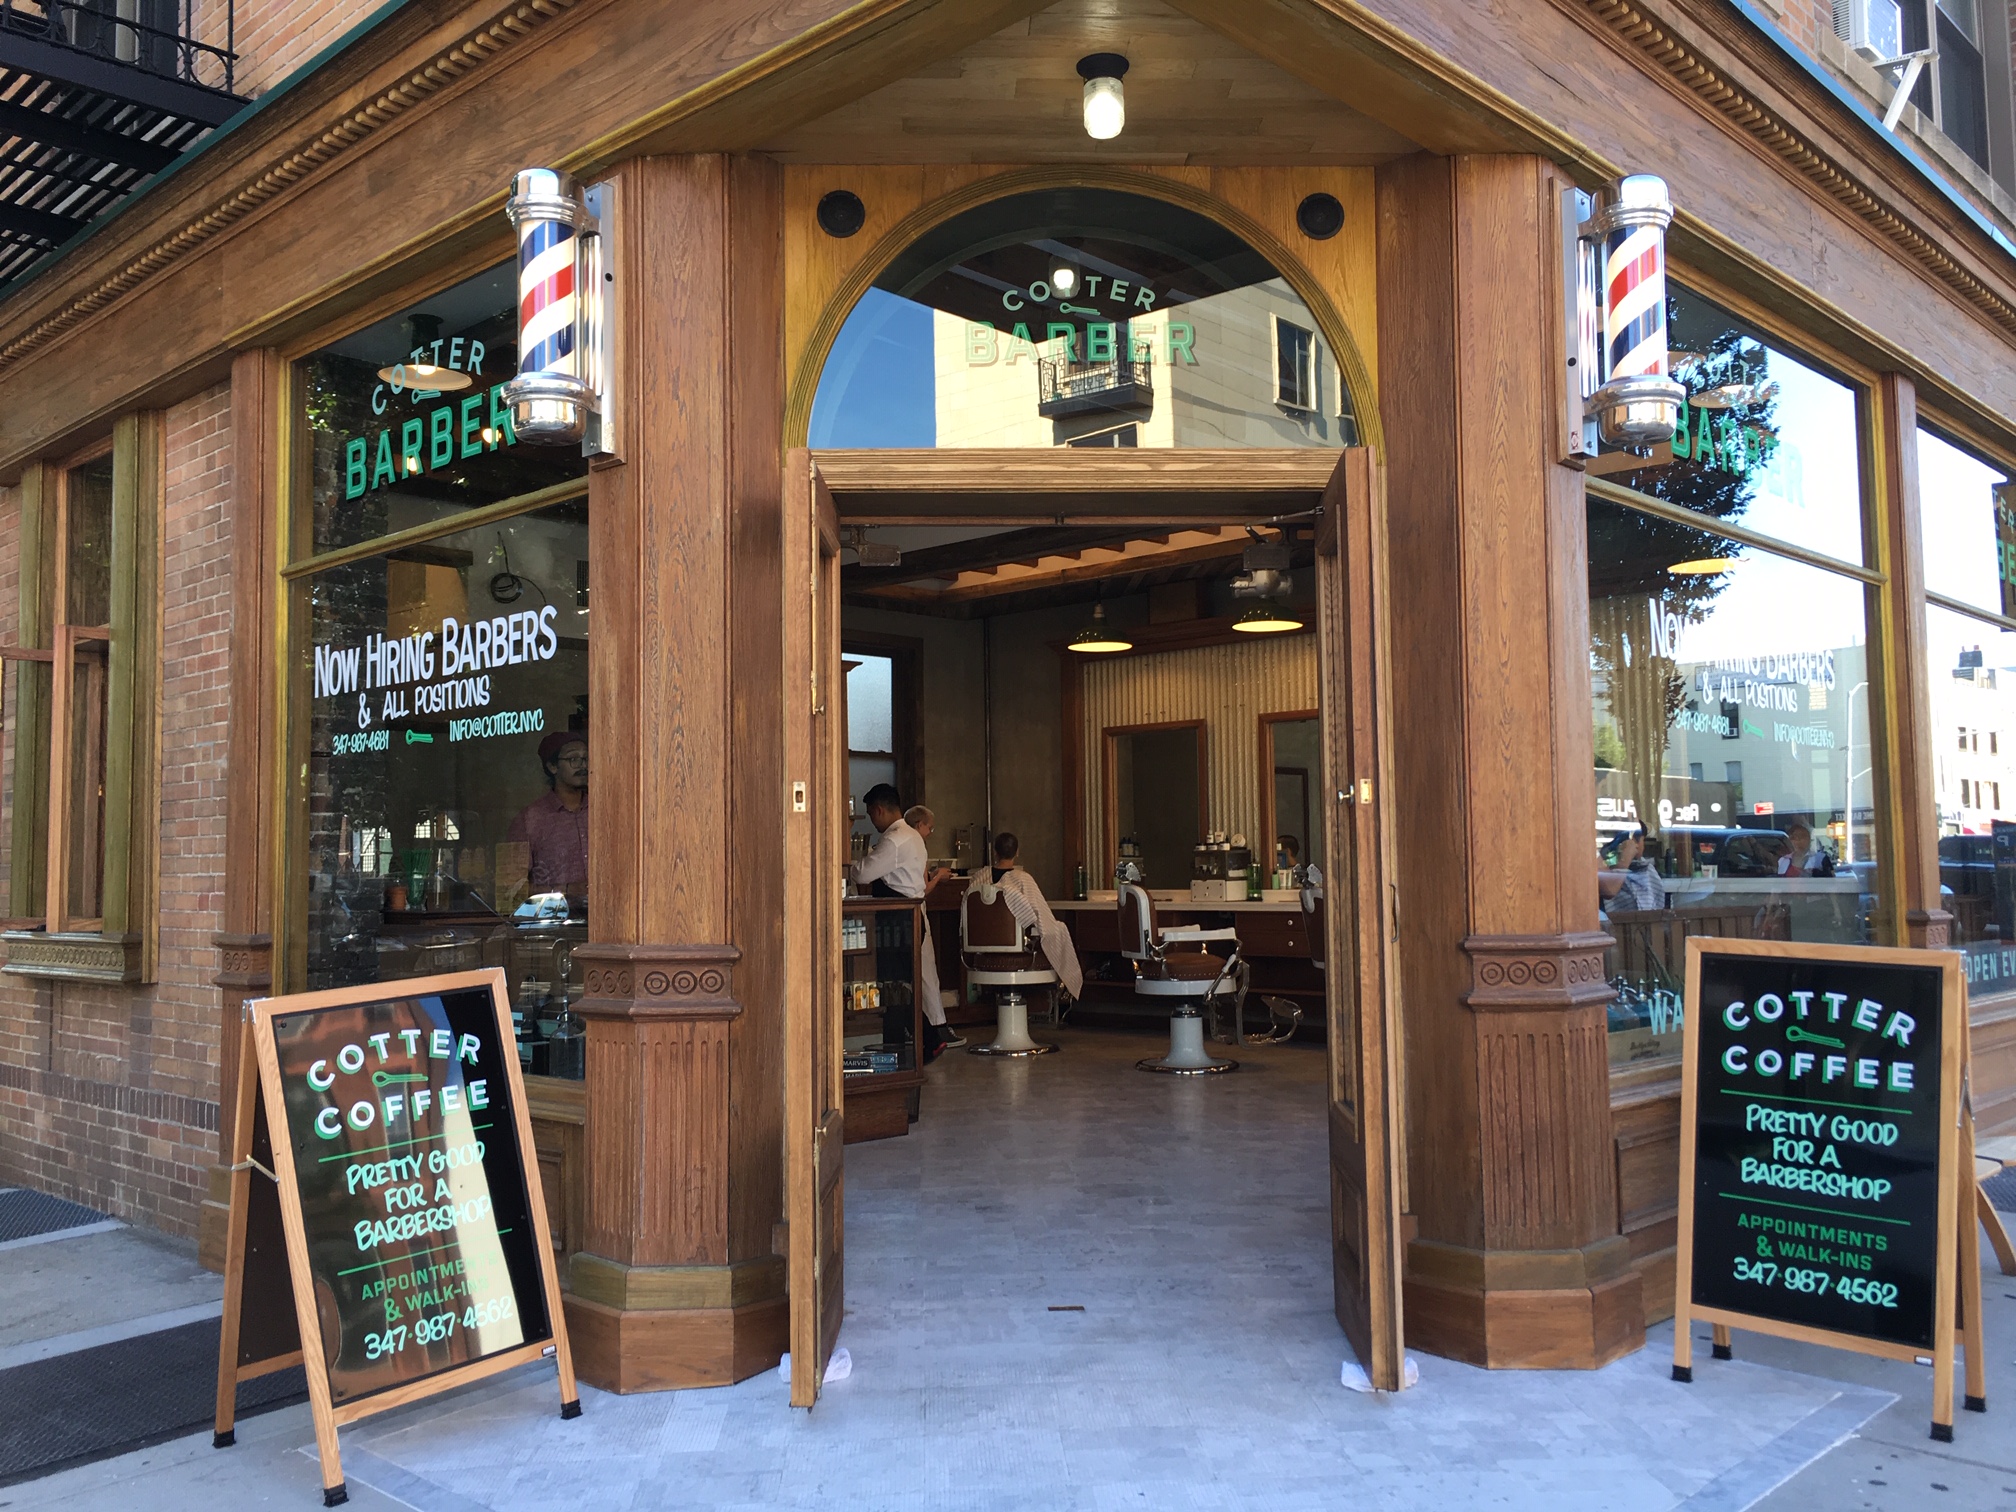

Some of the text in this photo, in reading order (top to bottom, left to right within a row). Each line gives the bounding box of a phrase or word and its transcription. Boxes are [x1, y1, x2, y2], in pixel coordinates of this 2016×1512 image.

[964, 321, 1200, 367] BARBER
[371, 337, 486, 416] COTTER
[345, 380, 518, 500] BARBER
[314, 604, 558, 699] NOW HIRING BARBERS
[357, 674, 491, 729] & ALL POSITIONS
[1702, 670, 1714, 704] &
[1719, 675, 1742, 704] ALL
[1744, 679, 1798, 713] POSITIONS
[449, 708, 545, 743] INFO@COTTER.NYC
[1966, 952, 1998, 984] OPEN
[1722, 990, 1917, 1047] COTTER
[306, 1027, 481, 1092] COTTER
[1720, 1044, 1915, 1093] COFFEE
[314, 1078, 490, 1141] COFFEE
[1745, 1104, 1899, 1147] PRETTY GOOD
[346, 1140, 486, 1195] PRETTY GOOD
[1772, 1136, 1842, 1169] FOR A
[384, 1176, 453, 1213] FOR A
[1740, 1157, 1892, 1202] BARBERSHOP
[353, 1194, 492, 1251] BARBERSHOP
[1737, 1212, 1889, 1252] APPOINTMENTS
[361, 1251, 500, 1301] APPOINTMENTS
[1756, 1234, 1873, 1271] & WALK-INS
[383, 1275, 490, 1322] & WALK-INS
